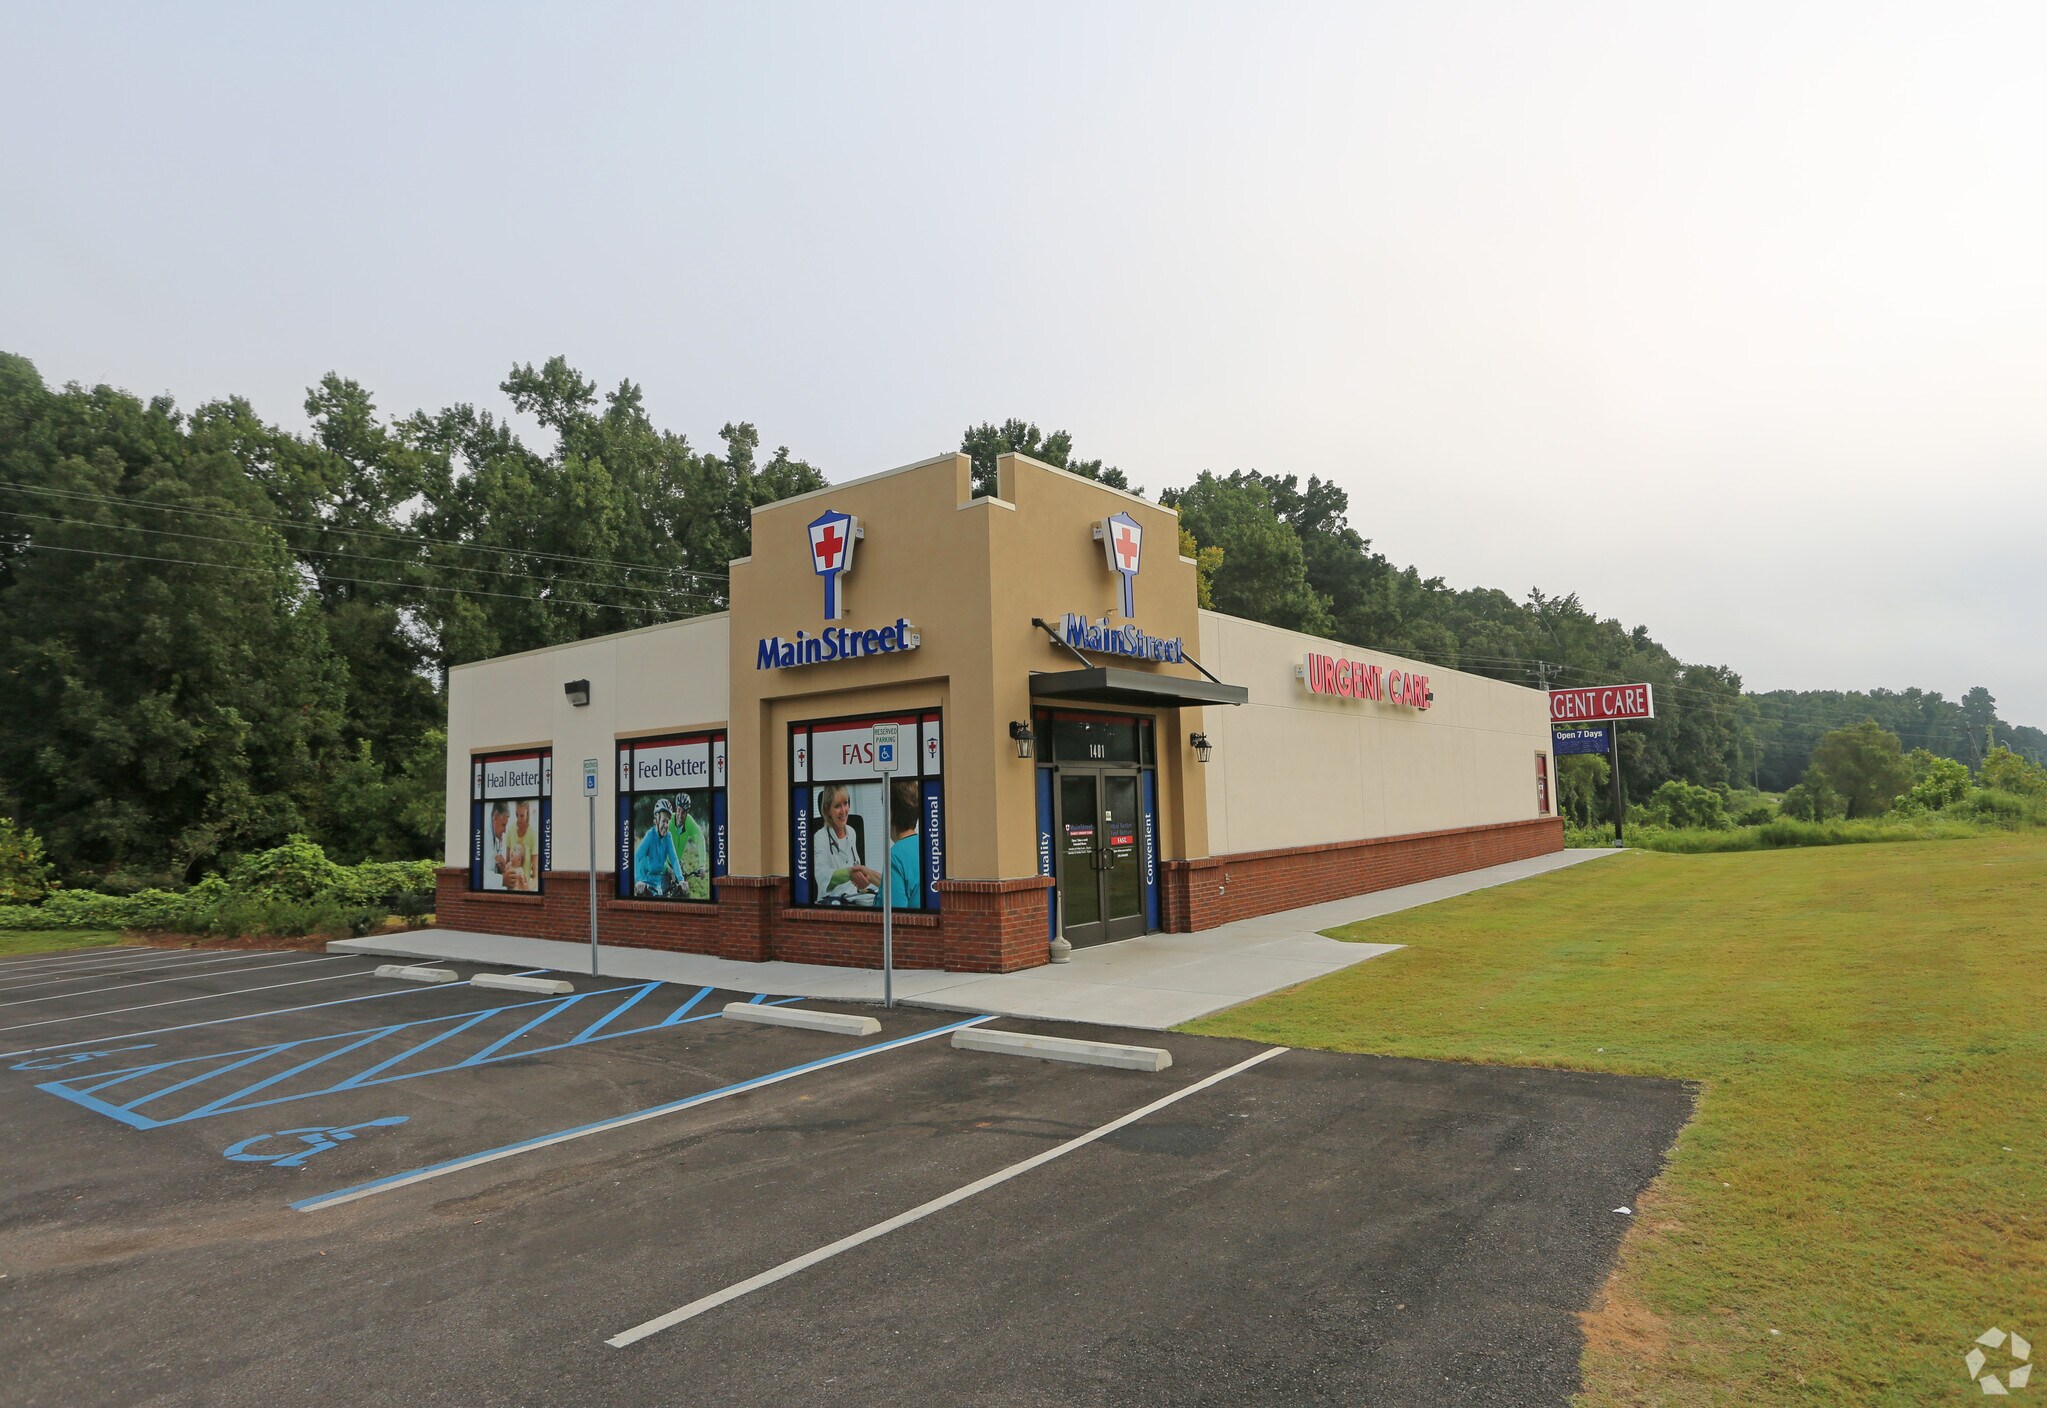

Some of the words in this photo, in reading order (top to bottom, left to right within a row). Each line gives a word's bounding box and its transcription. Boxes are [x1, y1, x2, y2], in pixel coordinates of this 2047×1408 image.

[757, 618, 908, 670] MainStreet
[1067, 613, 1185, 664] MainStreet
[1308, 653, 1382, 701] URGENT
[1389, 669, 1431, 708] CARE
[1549, 692, 1596, 718] GENT
[1602, 688, 1646, 715] CARE
[842, 742, 873, 765] FAS
[875, 727, 898, 735] RESERVED
[1556, 731, 1576, 740] Open
[1584, 730, 1603, 738] Days
[487, 770, 507, 788] Heal
[638, 758, 662, 778] Feel
[665, 758, 707, 777] Better.
[622, 819, 630, 871] Wellness
[716, 824, 726, 866] Sports
[797, 809, 808, 880] Affordable
[928, 796, 942, 893] Occupational
[1144, 812, 1153, 885] Convenient
